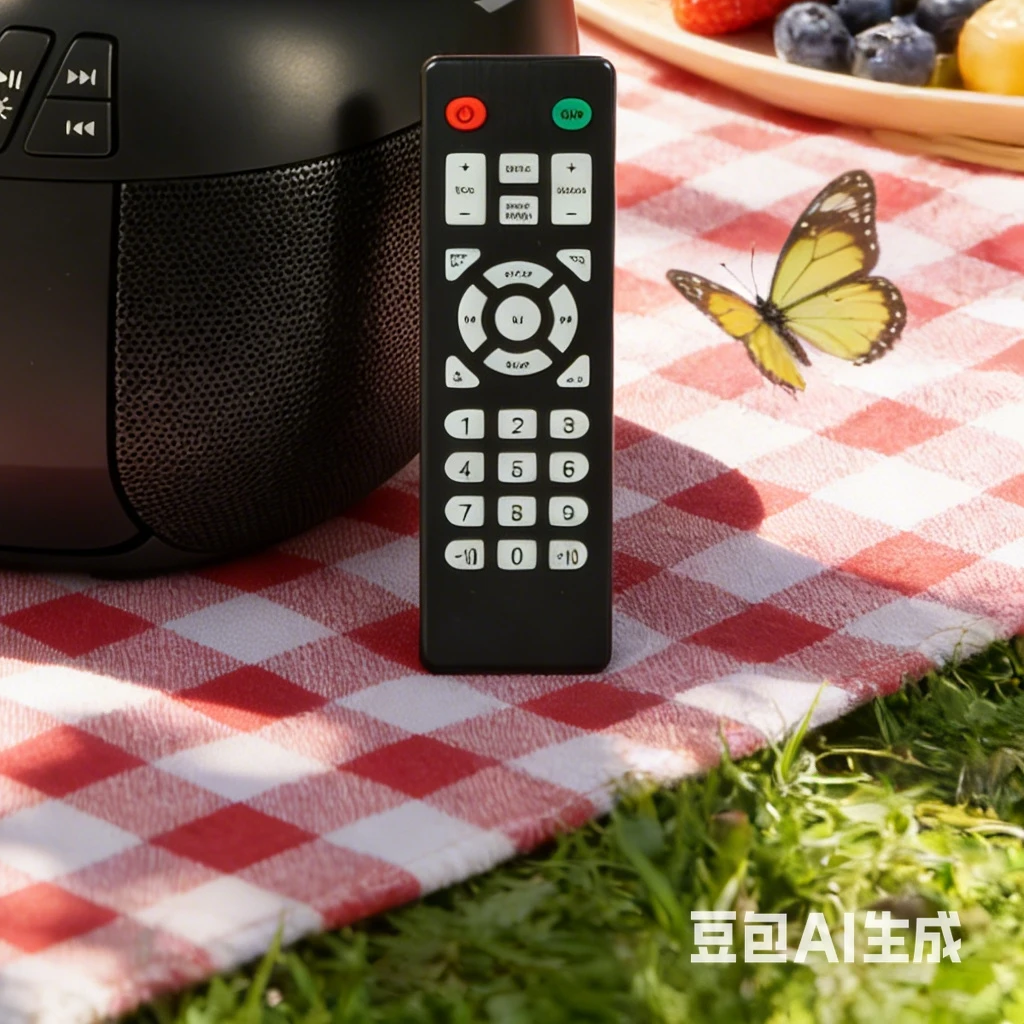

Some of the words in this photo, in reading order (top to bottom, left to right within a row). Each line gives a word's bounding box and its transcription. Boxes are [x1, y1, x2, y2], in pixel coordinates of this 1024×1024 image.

[461, 417, 469, 435] 1
[511, 417, 524, 435] 2
[458, 460, 471, 477] 4
[511, 460, 523, 478] 5
[562, 460, 575, 478] 6
[458, 504, 472, 521] 7
[562, 504, 575, 521] 9
[511, 547, 523, 565] 0
